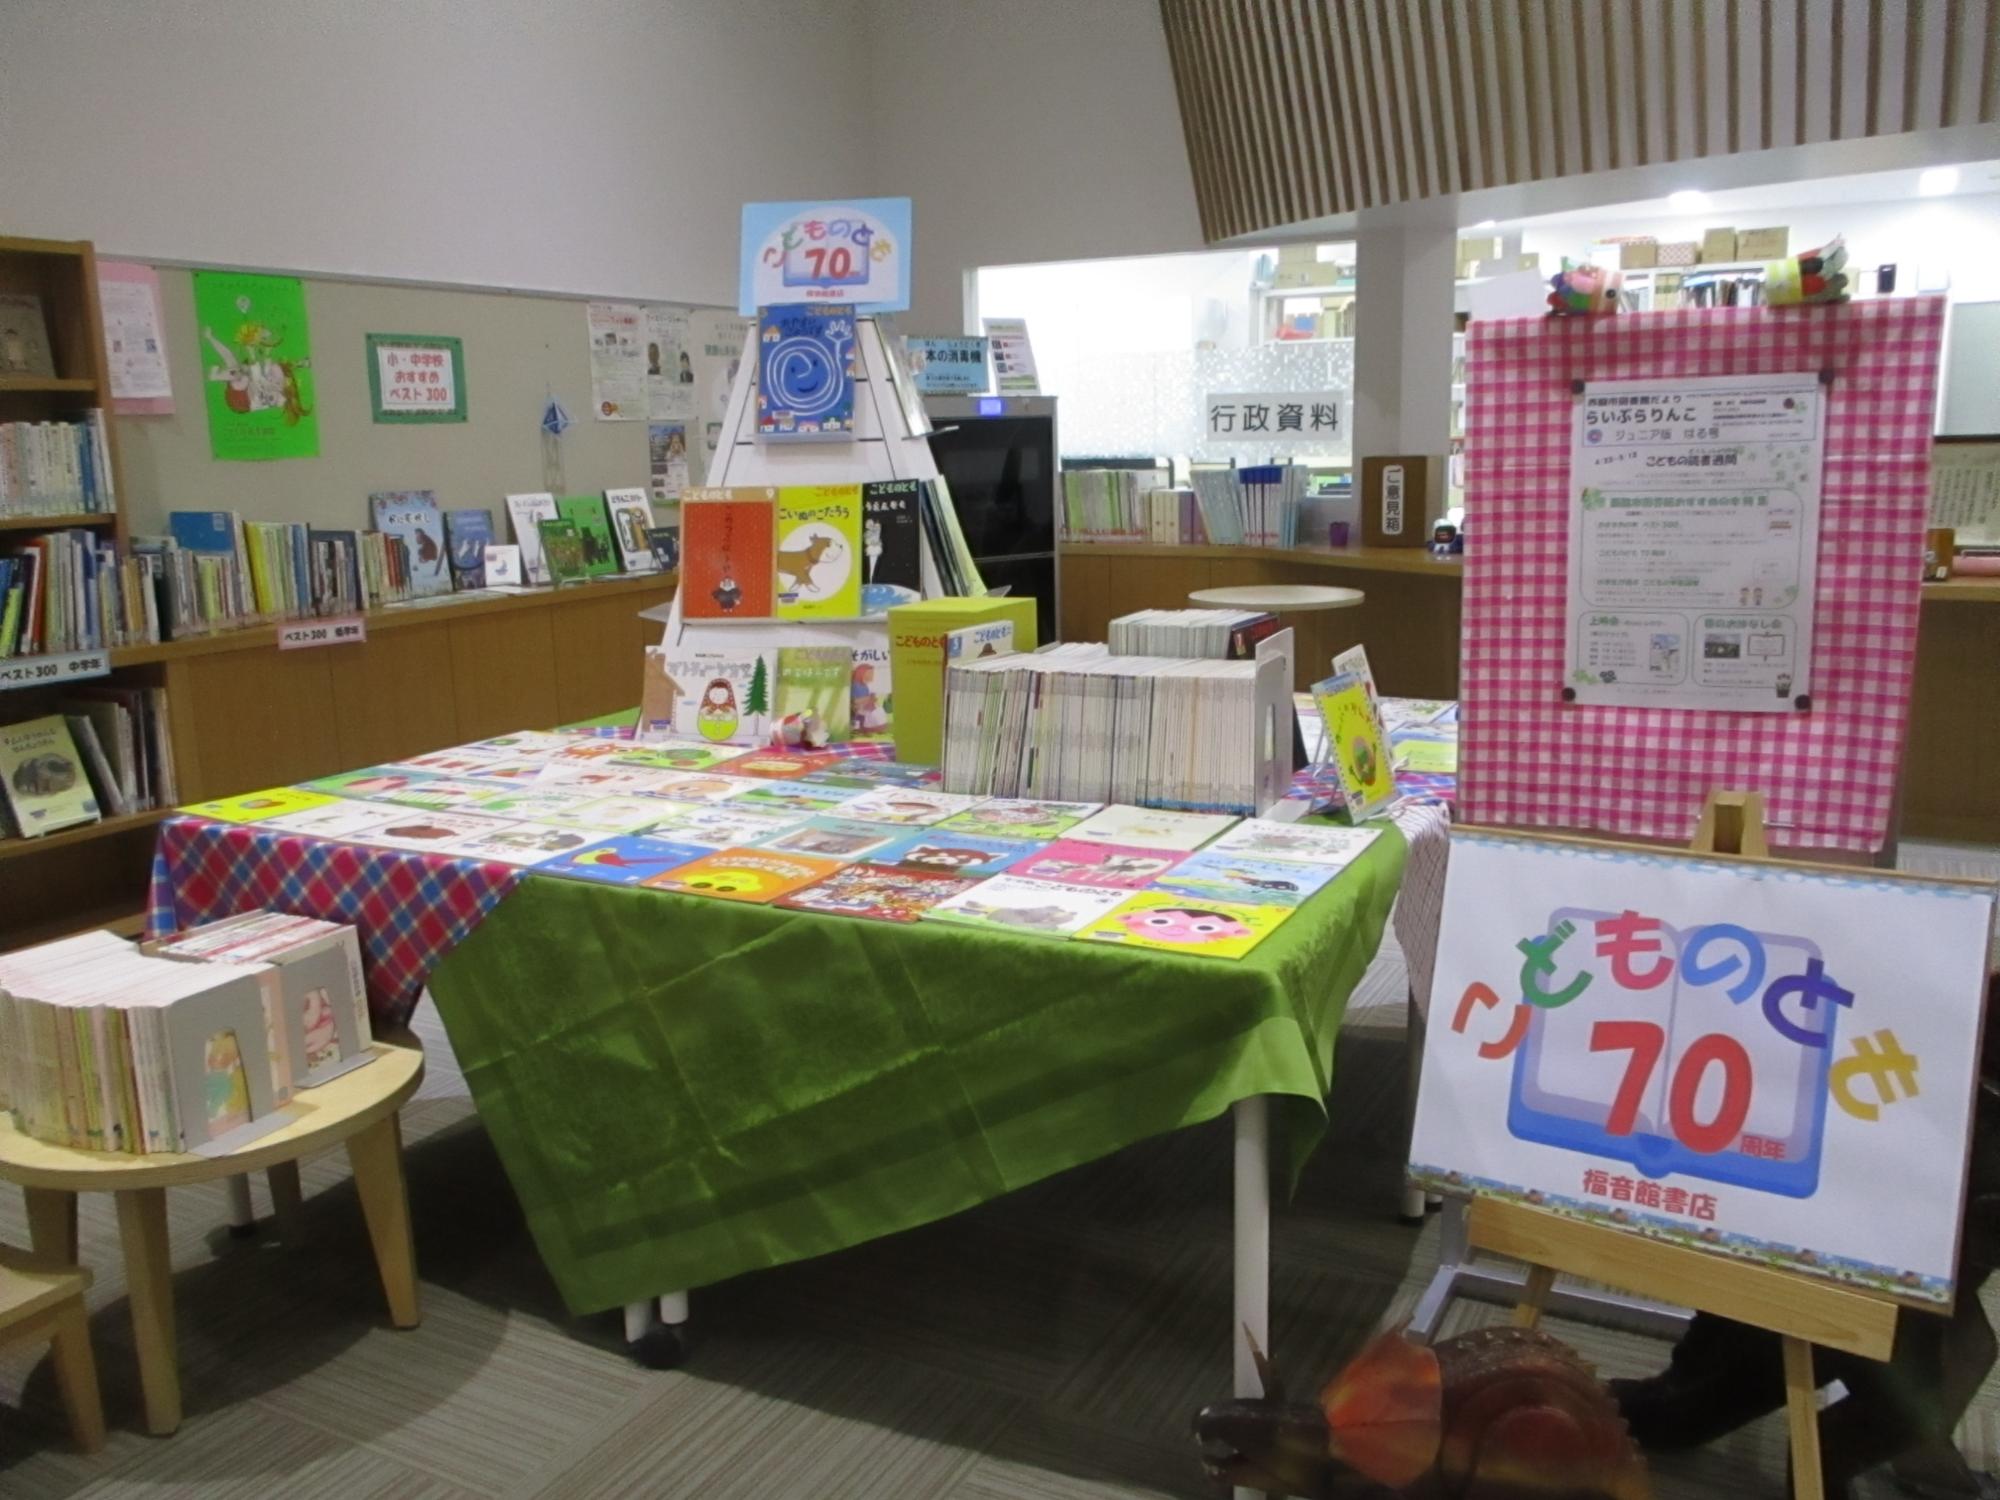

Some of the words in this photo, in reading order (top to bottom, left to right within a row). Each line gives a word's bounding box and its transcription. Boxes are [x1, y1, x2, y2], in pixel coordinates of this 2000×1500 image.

[394, 370, 439, 384] おすすめ
[1210, 402, 1338, 433] 行政資料
[1586, 407, 1697, 425] らいぶらりんこ
[1385, 468, 1402, 532] ご意見箱
[1451, 910, 1920, 1122] こどものとも
[1582, 1168, 1719, 1222] 福音館書店
